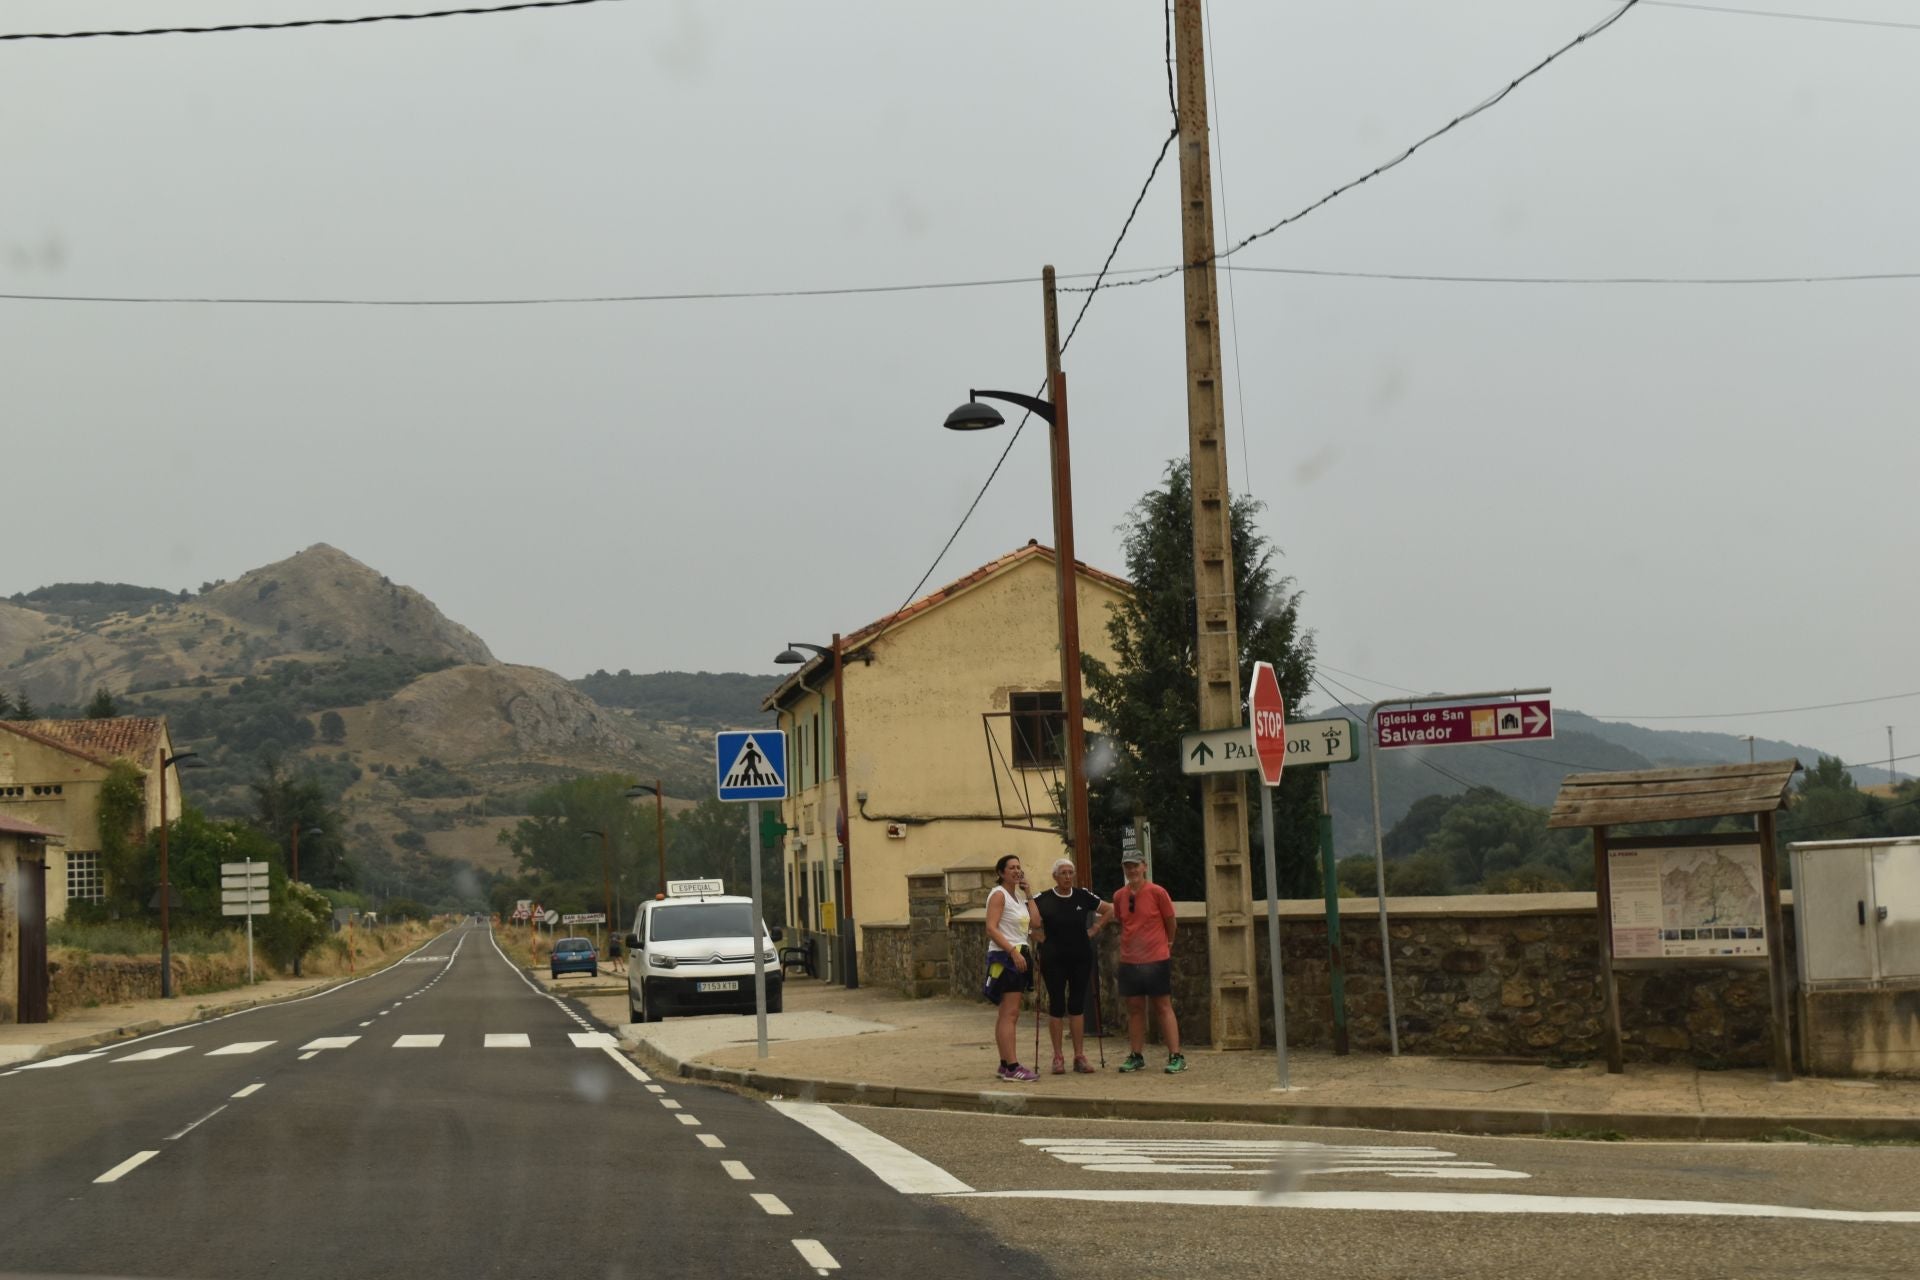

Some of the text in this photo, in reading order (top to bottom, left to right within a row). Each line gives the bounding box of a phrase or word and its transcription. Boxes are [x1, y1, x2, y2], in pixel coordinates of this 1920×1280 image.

[1422, 711, 1437, 722] de
[1442, 709, 1464, 721] San
[1256, 710, 1282, 739] STOP
[1381, 725, 1452, 743] Salvador
[1224, 738, 1311, 760] PAOR
[679, 884, 713, 892] ESPECIAL
[702, 982, 721, 991] 7153
